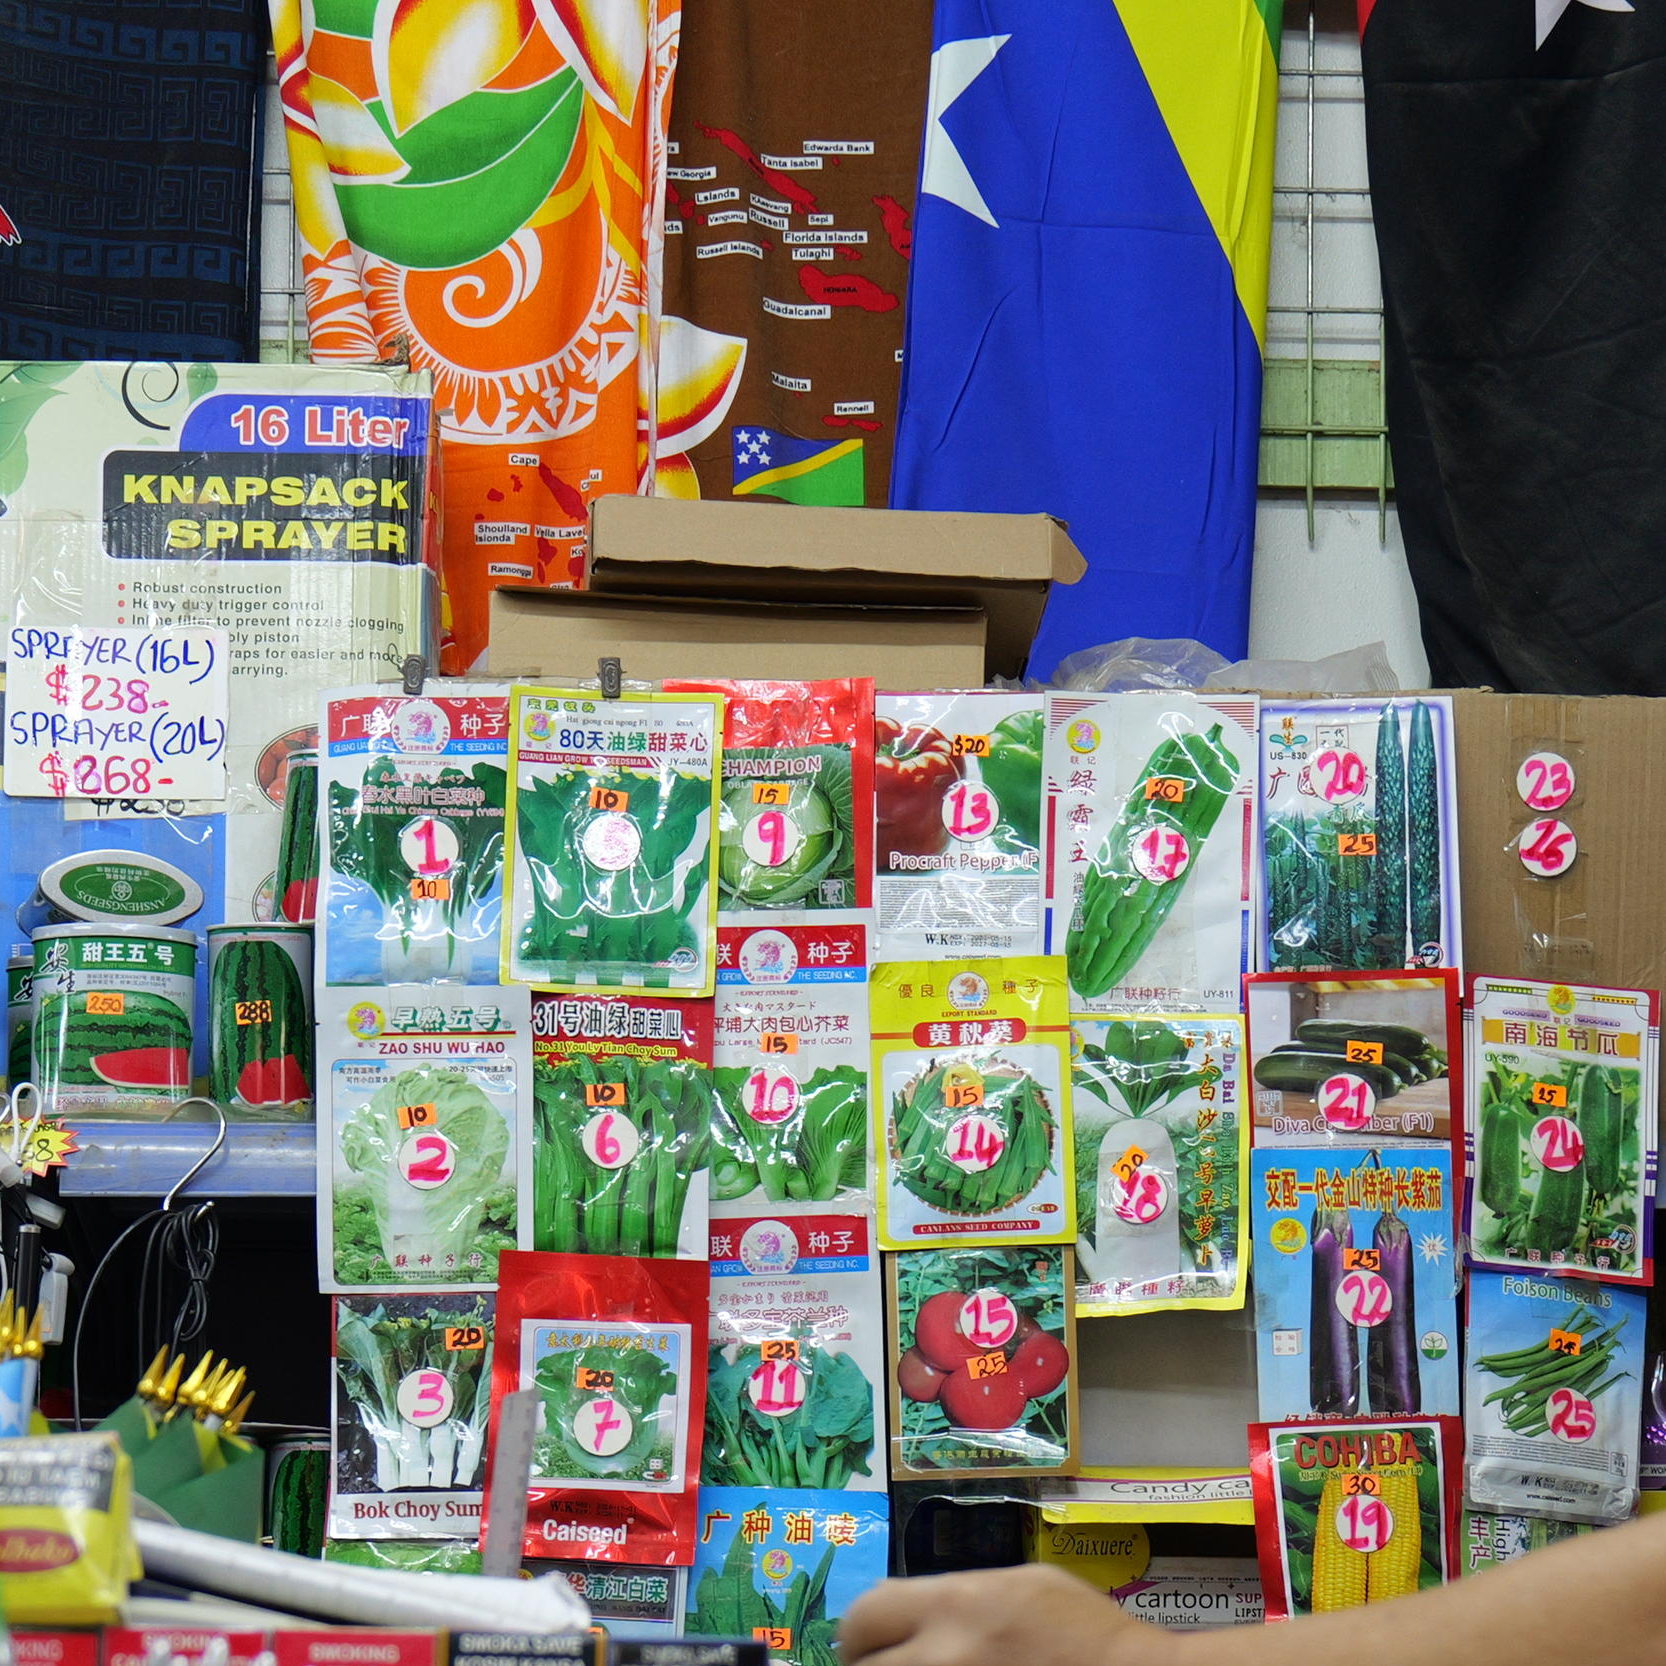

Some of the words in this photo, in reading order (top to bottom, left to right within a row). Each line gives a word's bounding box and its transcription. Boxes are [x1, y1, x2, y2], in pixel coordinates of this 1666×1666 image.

[847, 144, 870, 152] Bank
[785, 232, 821, 242] Florida
[793, 249, 831, 260] Tulaghi
[232, 407, 287, 443] 16
[305, 409, 409, 449] Liter
[510, 454, 538, 467] Cape
[123, 473, 409, 510] KNAPSACK
[167, 518, 408, 552] SPRAYER
[133, 582, 184, 594] Robust
[190, 582, 283, 594] construction
[219, 600, 267, 613] trigger
[273, 600, 325, 611] control
[217, 616, 231, 627] to
[236, 617, 291, 629] prevent
[348, 617, 404, 634] clogging
[254, 632, 300, 645] piston
[265, 648, 285, 660] for
[290, 649, 334, 660] easier
[340, 649, 365, 661] and
[10, 711, 146, 747] SPRAYER
[149, 711, 226, 763] (20L)
[460, 713, 506, 739] 种子
[559, 728, 709, 752] 80天油绿甜菜心
[954, 737, 985, 754] $20
[1317, 750, 1366, 801] 20
[1523, 759, 1571, 809] 23
[949, 784, 992, 837] 13
[413, 819, 450, 875] 1
[757, 811, 785, 865] 9
[1344, 835, 1374, 853] 25
[889, 851, 956, 871] Procraft
[959, 853, 1020, 873] Pepper
[1140, 828, 1188, 881] 17
[81, 941, 175, 966] 甜王五号
[807, 941, 854, 965] 种子
[90, 995, 122, 1013] 250
[238, 1001, 270, 1022] 288
[391, 1004, 502, 1032] 早熟五号
[533, 1003, 682, 1040] 31号油绿甜菜心
[379, 1042, 409, 1055] ZAO
[413, 1042, 443, 1055] SHU
[447, 1042, 471, 1055] WU
[626, 1043, 652, 1056] Choy
[1504, 1022, 1619, 1056] 南海节瓜
[1324, 1078, 1369, 1124] 21
[1272, 1117, 1311, 1135] Diva
[1402, 1111, 1434, 1134] (F1)
[594, 1114, 621, 1165] 6
[951, 1119, 1005, 1166] 14
[1536, 1118, 1585, 1168] 24
[408, 1137, 451, 1181] 2
[1265, 1167, 1443, 1211] 交配一代金山特种长紫茄
[964, 1222, 989, 1232] SEED
[990, 1221, 1034, 1231] COMPANY
[1341, 1276, 1392, 1325] 22
[1502, 1277, 1559, 1302] Foison
[1562, 1284, 1613, 1308] Beans
[964, 1296, 1013, 1345] 15
[412, 1373, 445, 1418] 3
[752, 1359, 805, 1411] 11
[592, 1399, 621, 1452] 7
[1550, 1390, 1597, 1439] 25
[1294, 1431, 1422, 1469] COHIBA
[1110, 1482, 1208, 1495] Candy
[1348, 1475, 1376, 1495] 30
[353, 1502, 390, 1520] Bok
[394, 1502, 441, 1524] Choy
[444, 1501, 484, 1518] Sum
[1341, 1495, 1389, 1550] 19
[542, 1519, 627, 1546] Caiseed
[1051, 1531, 1134, 1557] Daixuere
[1135, 1590, 1229, 1610] cartoon
[1158, 1612, 1201, 1626] lipstick
[310, 1644, 401, 1664] SMOKING
